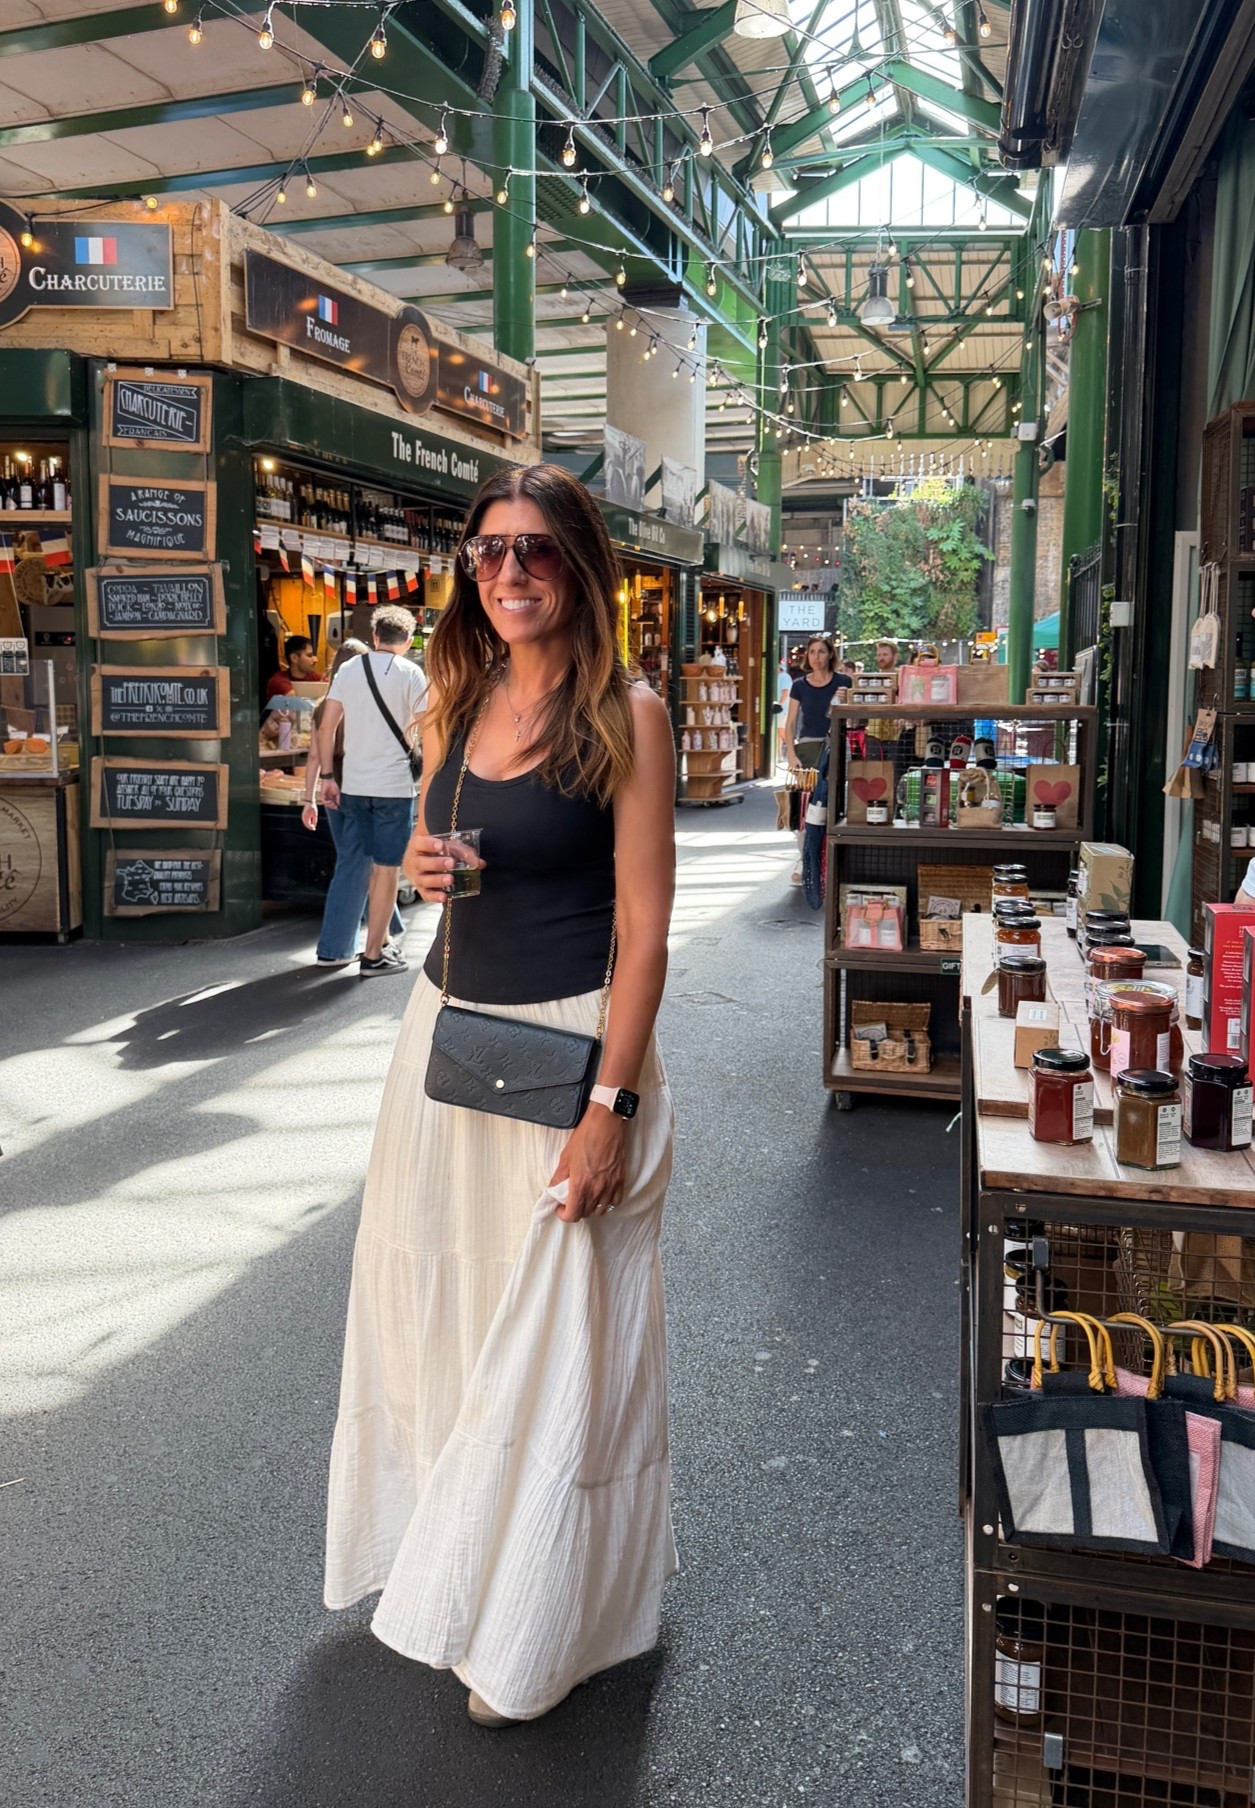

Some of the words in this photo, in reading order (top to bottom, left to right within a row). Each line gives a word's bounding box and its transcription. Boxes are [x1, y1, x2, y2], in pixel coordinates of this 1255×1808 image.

[29, 266, 167, 292] CHARCUTERIE
[306, 316, 351, 354] FROMAGE
[463, 385, 505, 418] CHARCUTERIE
[391, 431, 412, 462] The
[415, 439, 448, 474] French
[451, 452, 479, 483] Comté
[131, 490, 138, 502] A
[138, 488, 170, 500] RANGE
[174, 493, 186, 504] OF
[115, 508, 203, 527] SAUCISSONS
[126, 529, 186, 547] MAGNIFIQUE
[108, 602, 133, 612] DUCK
[788, 605, 816, 615] THE
[783, 617, 821, 628] YARD
[116, 794, 154, 810] TUESDAY
[165, 796, 202, 812] SUNDAY
[1, 806, 32, 839] MARKET
[942, 962, 961, 970] GIFT
